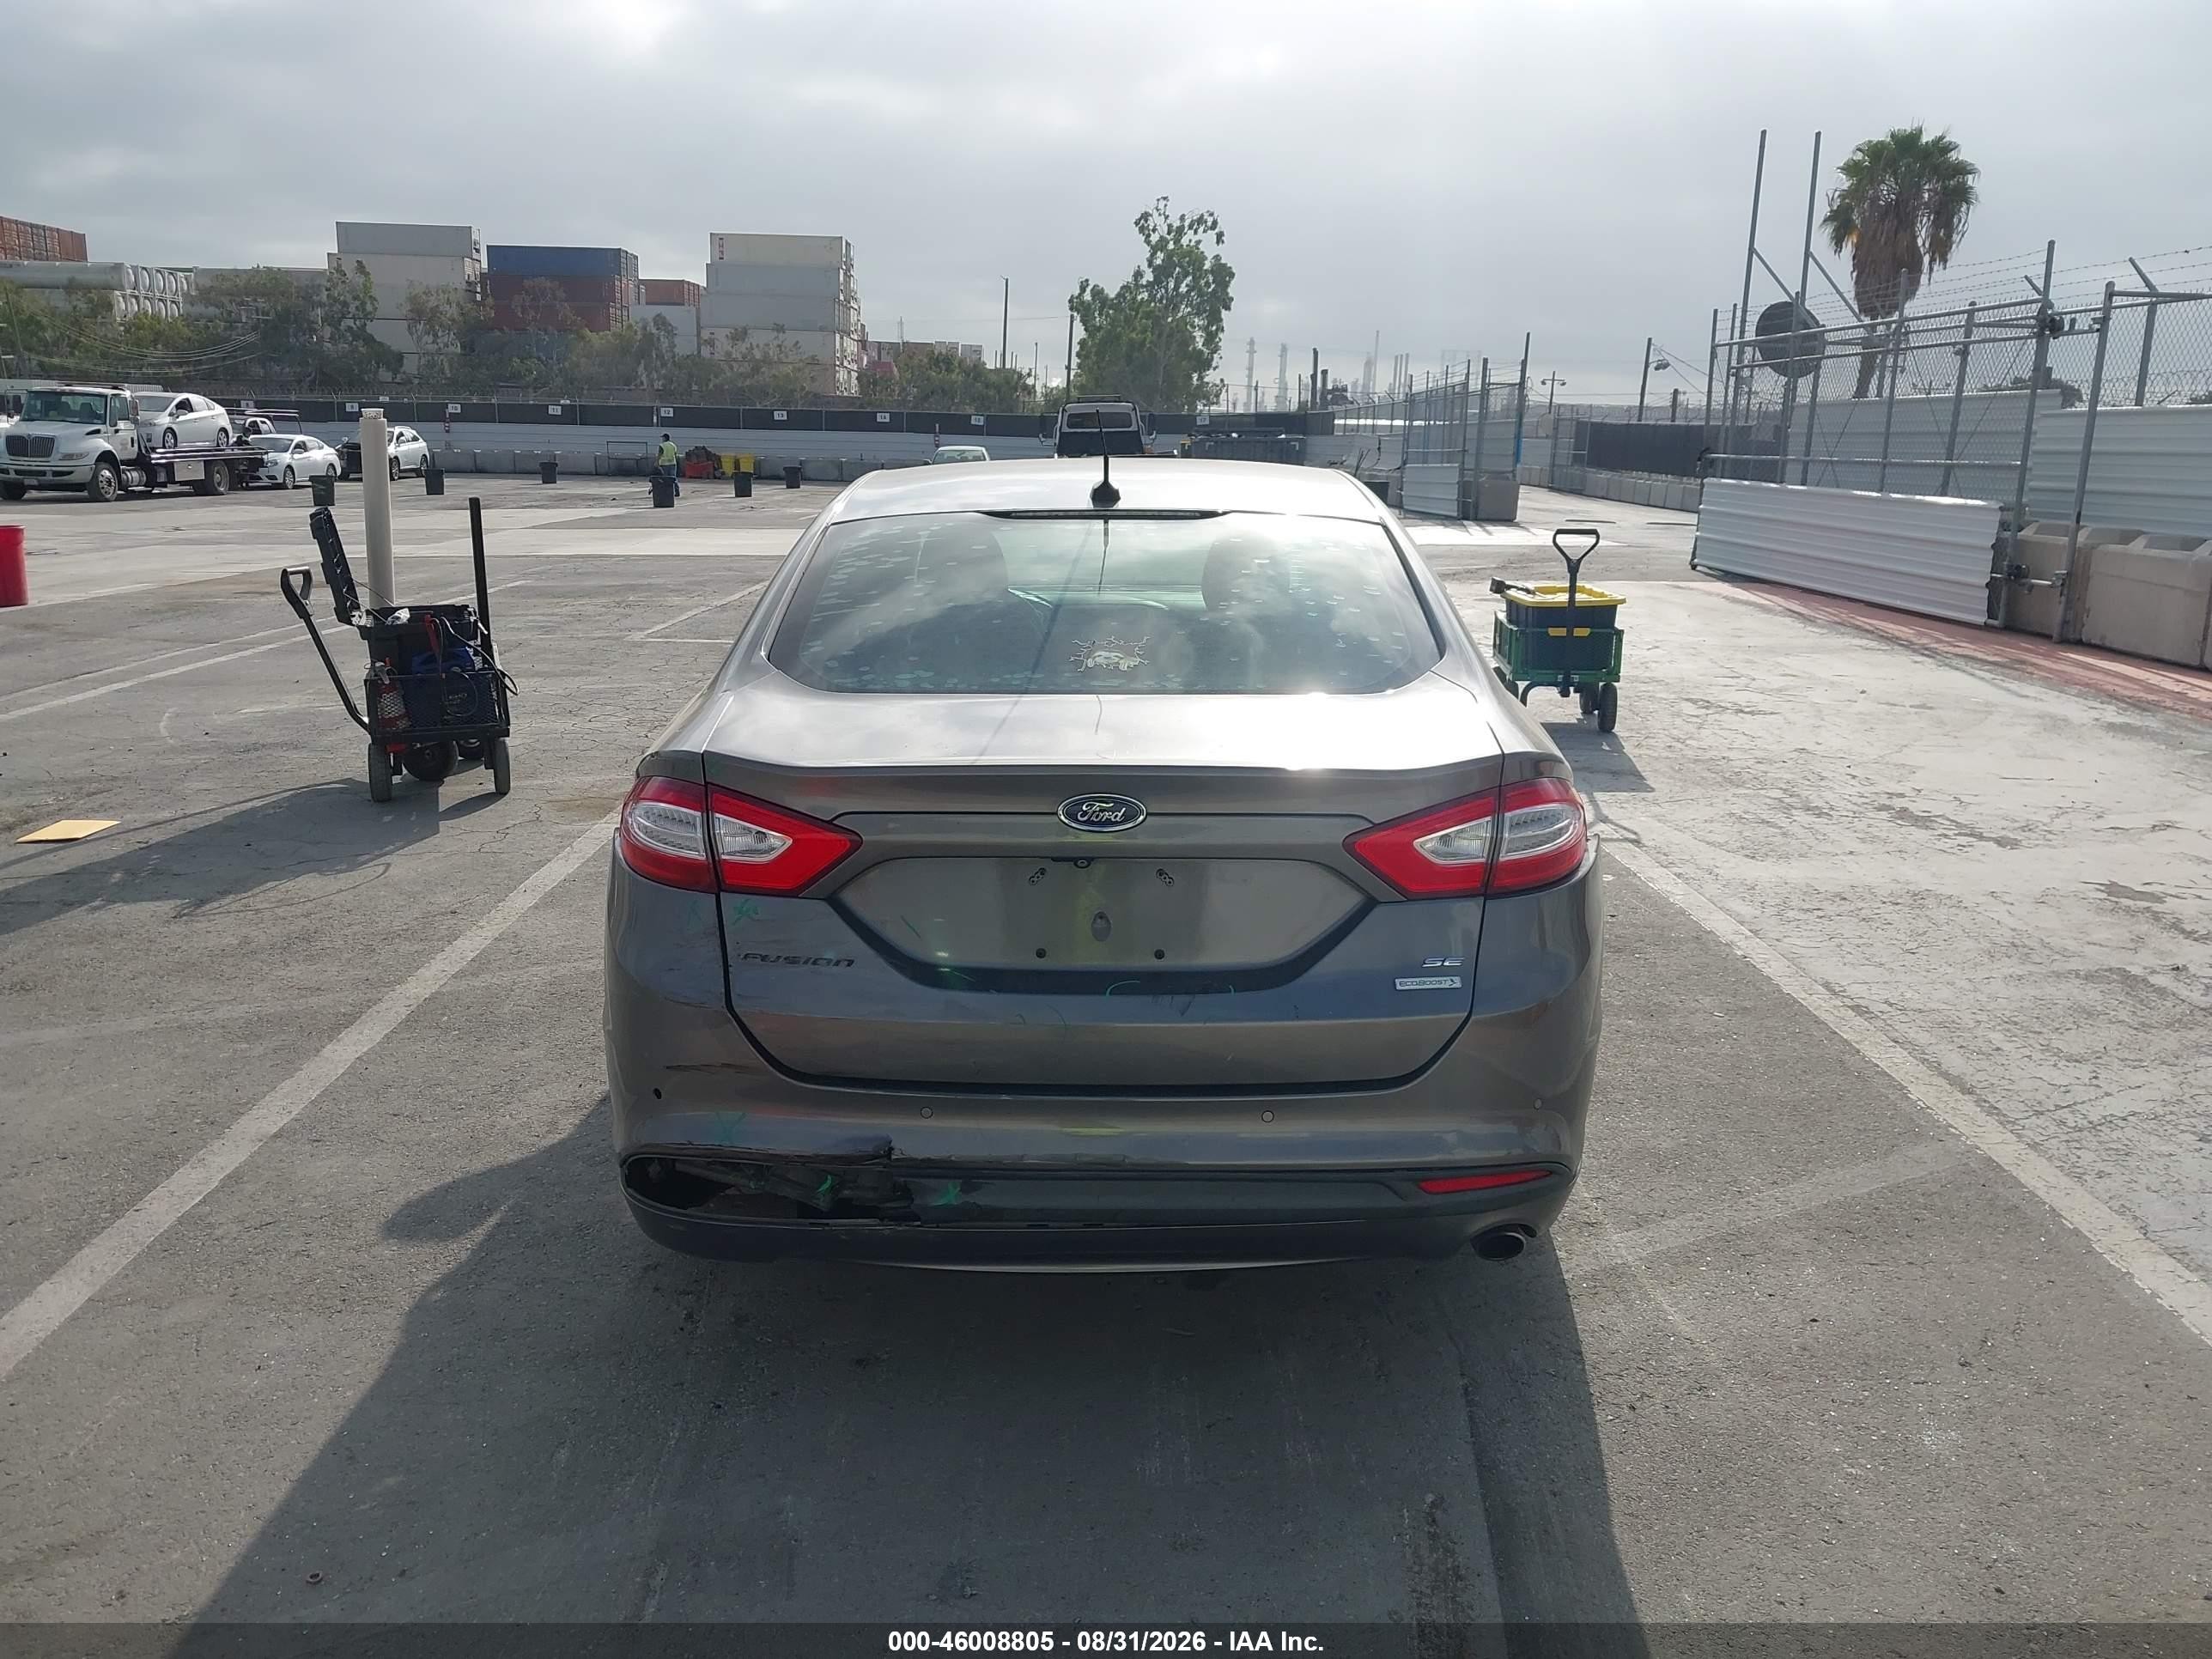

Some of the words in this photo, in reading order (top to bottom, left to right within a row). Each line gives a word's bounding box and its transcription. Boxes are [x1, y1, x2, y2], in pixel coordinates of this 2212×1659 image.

[1077, 801, 1127, 822] Ford
[741, 952, 855, 967] FUSION
[1422, 957, 1465, 967] SE
